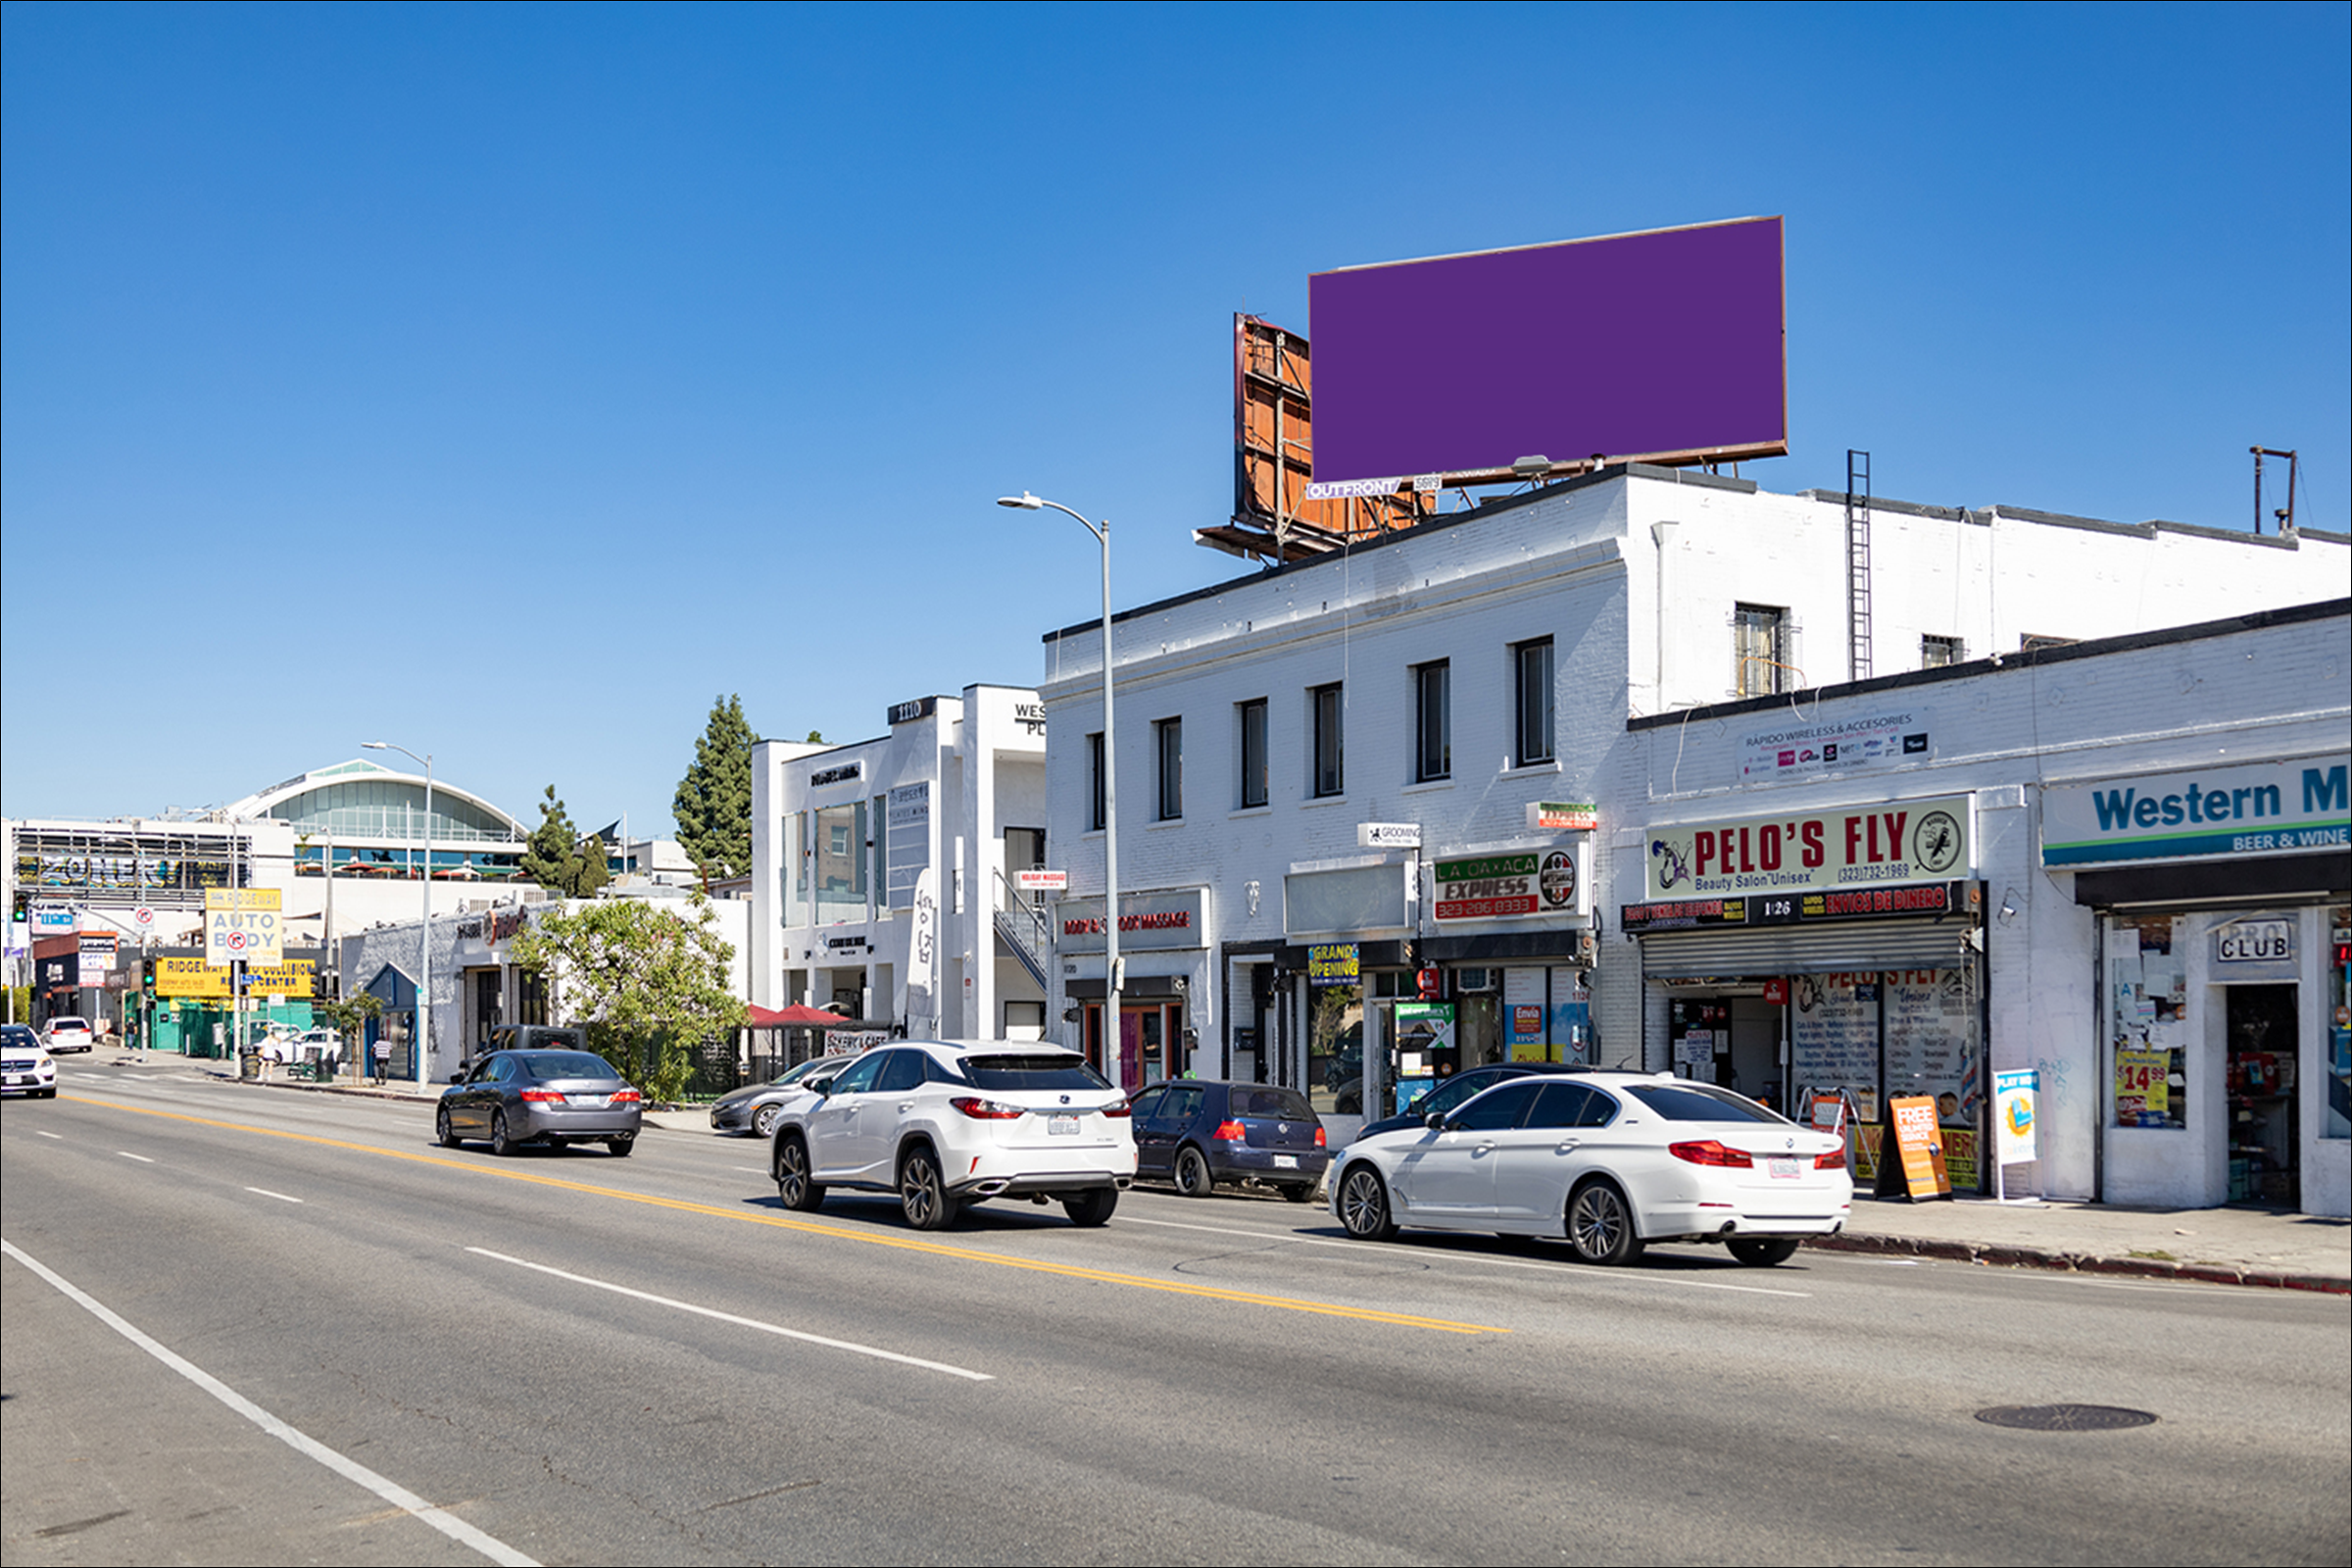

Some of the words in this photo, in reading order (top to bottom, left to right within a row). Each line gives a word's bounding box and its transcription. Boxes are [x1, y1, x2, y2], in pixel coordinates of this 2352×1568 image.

[1309, 480, 1395, 498] OUTFRONT
[898, 701, 921, 721] 1110
[1785, 726, 1835, 741] WIRELESS
[1837, 724, 1844, 734] &
[1846, 714, 1912, 731] ACCESORIES
[2091, 783, 2280, 831] Western
[2301, 765, 2348, 812] M
[1382, 826, 1421, 839] GROOMING
[2232, 835, 2276, 851] BEER
[2278, 833, 2294, 847] &
[2298, 828, 2347, 845] WINE
[1695, 820, 1825, 877] PELO'S
[1844, 811, 1908, 865] FLY
[1437, 864, 1461, 880] LA
[1468, 858, 1537, 877] OAXACA
[1695, 877, 1734, 892] Beauty
[1736, 874, 1766, 889] Salon
[1838, 862, 1910, 883] (323)732-1969
[1445, 877, 1530, 901] EXPRESS
[226, 892, 277, 906] RDGEWAY
[1438, 898, 1531, 917] 323-286-8333
[1826, 893, 1870, 913] ENVIOS
[1870, 891, 1892, 911] DE
[1893, 887, 1945, 909] DINERO
[214, 912, 274, 929] AUTO
[1064, 920, 1090, 935] BODY
[1141, 910, 1191, 930] MASSAGE
[214, 932, 274, 948] BDY
[2221, 937, 2287, 958] CLUB
[1313, 944, 1353, 959] GRAND
[167, 960, 223, 973] RIDGEWAY
[263, 963, 312, 976] COLLISION
[1308, 959, 1359, 977] OPENING
[259, 977, 297, 987] CENTER
[2120, 983, 2132, 997] A
[1997, 1077, 2018, 1090] PLAY
[1897, 1105, 1935, 1124] FREE
[1899, 1123, 1935, 1133] UNLIMITED
[1901, 1131, 1930, 1143] SERVICE
